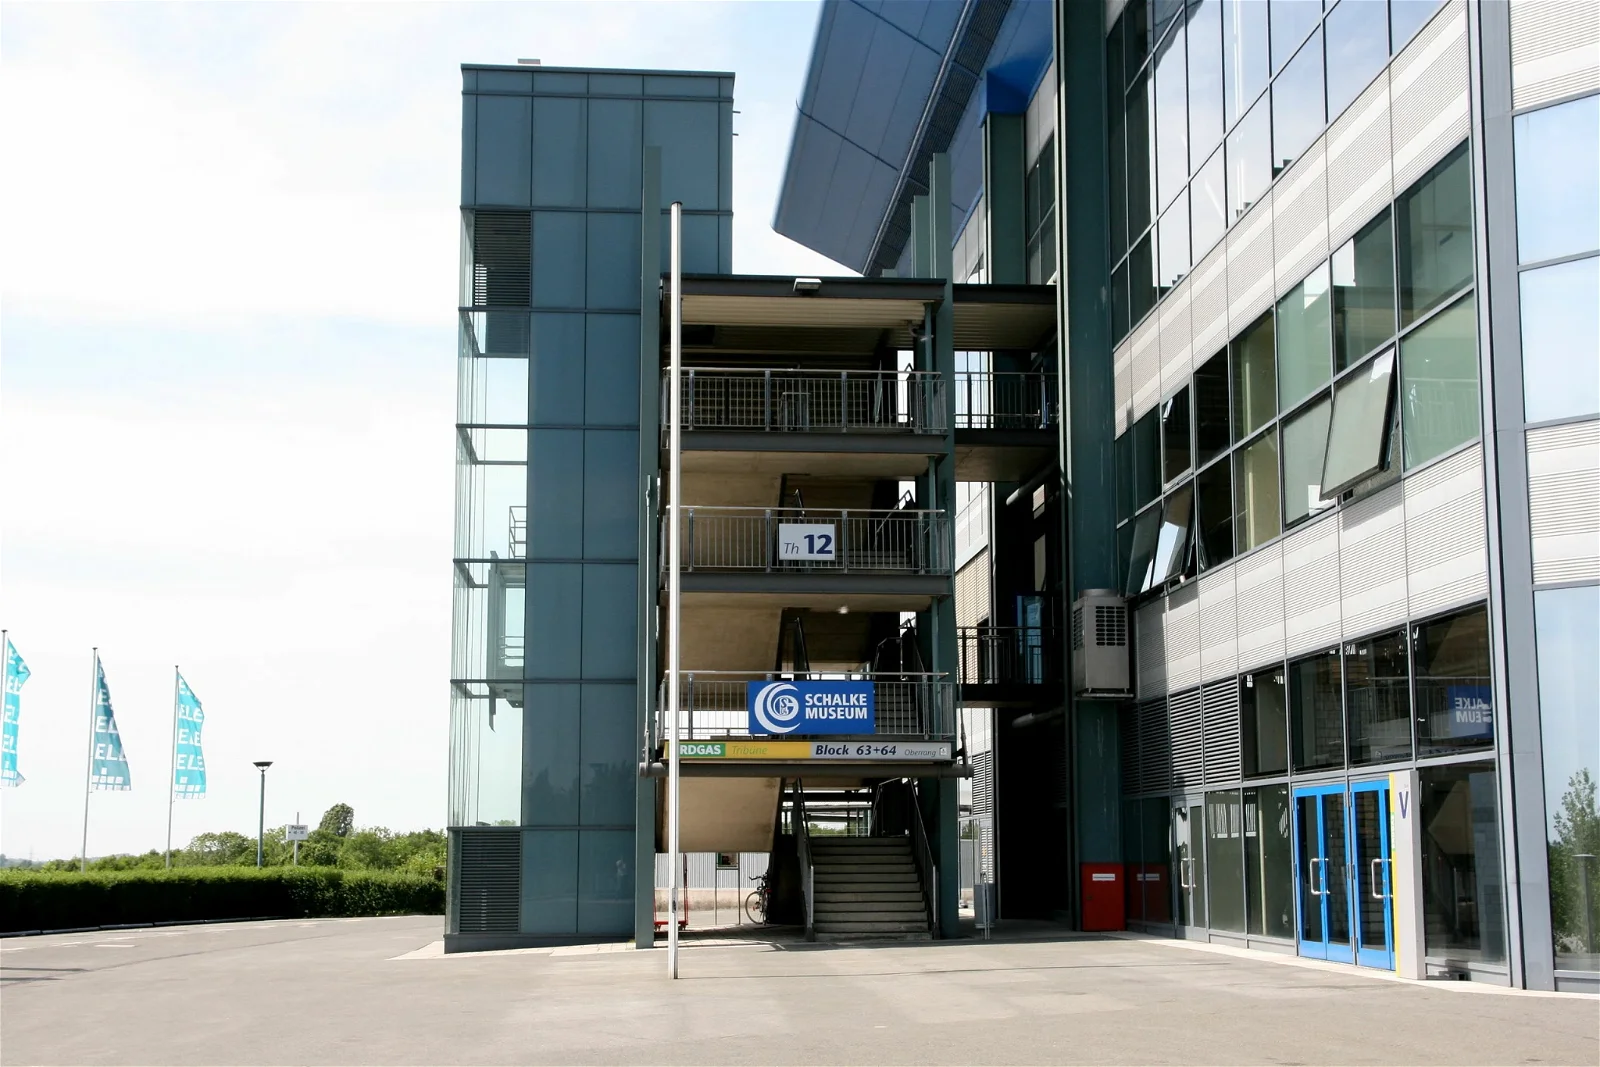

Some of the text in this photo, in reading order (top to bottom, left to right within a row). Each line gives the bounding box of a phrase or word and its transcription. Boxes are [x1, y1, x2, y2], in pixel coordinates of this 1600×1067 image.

[784, 534, 833, 555] Th 12
[804, 693, 867, 706] SCHALKE
[805, 707, 868, 719] MUSEUM
[680, 744, 721, 755] RDGAS
[815, 744, 849, 756] Block
[856, 744, 897, 756] 63+64
[904, 749, 937, 758] Oberrang
[1398, 790, 1409, 819] V
